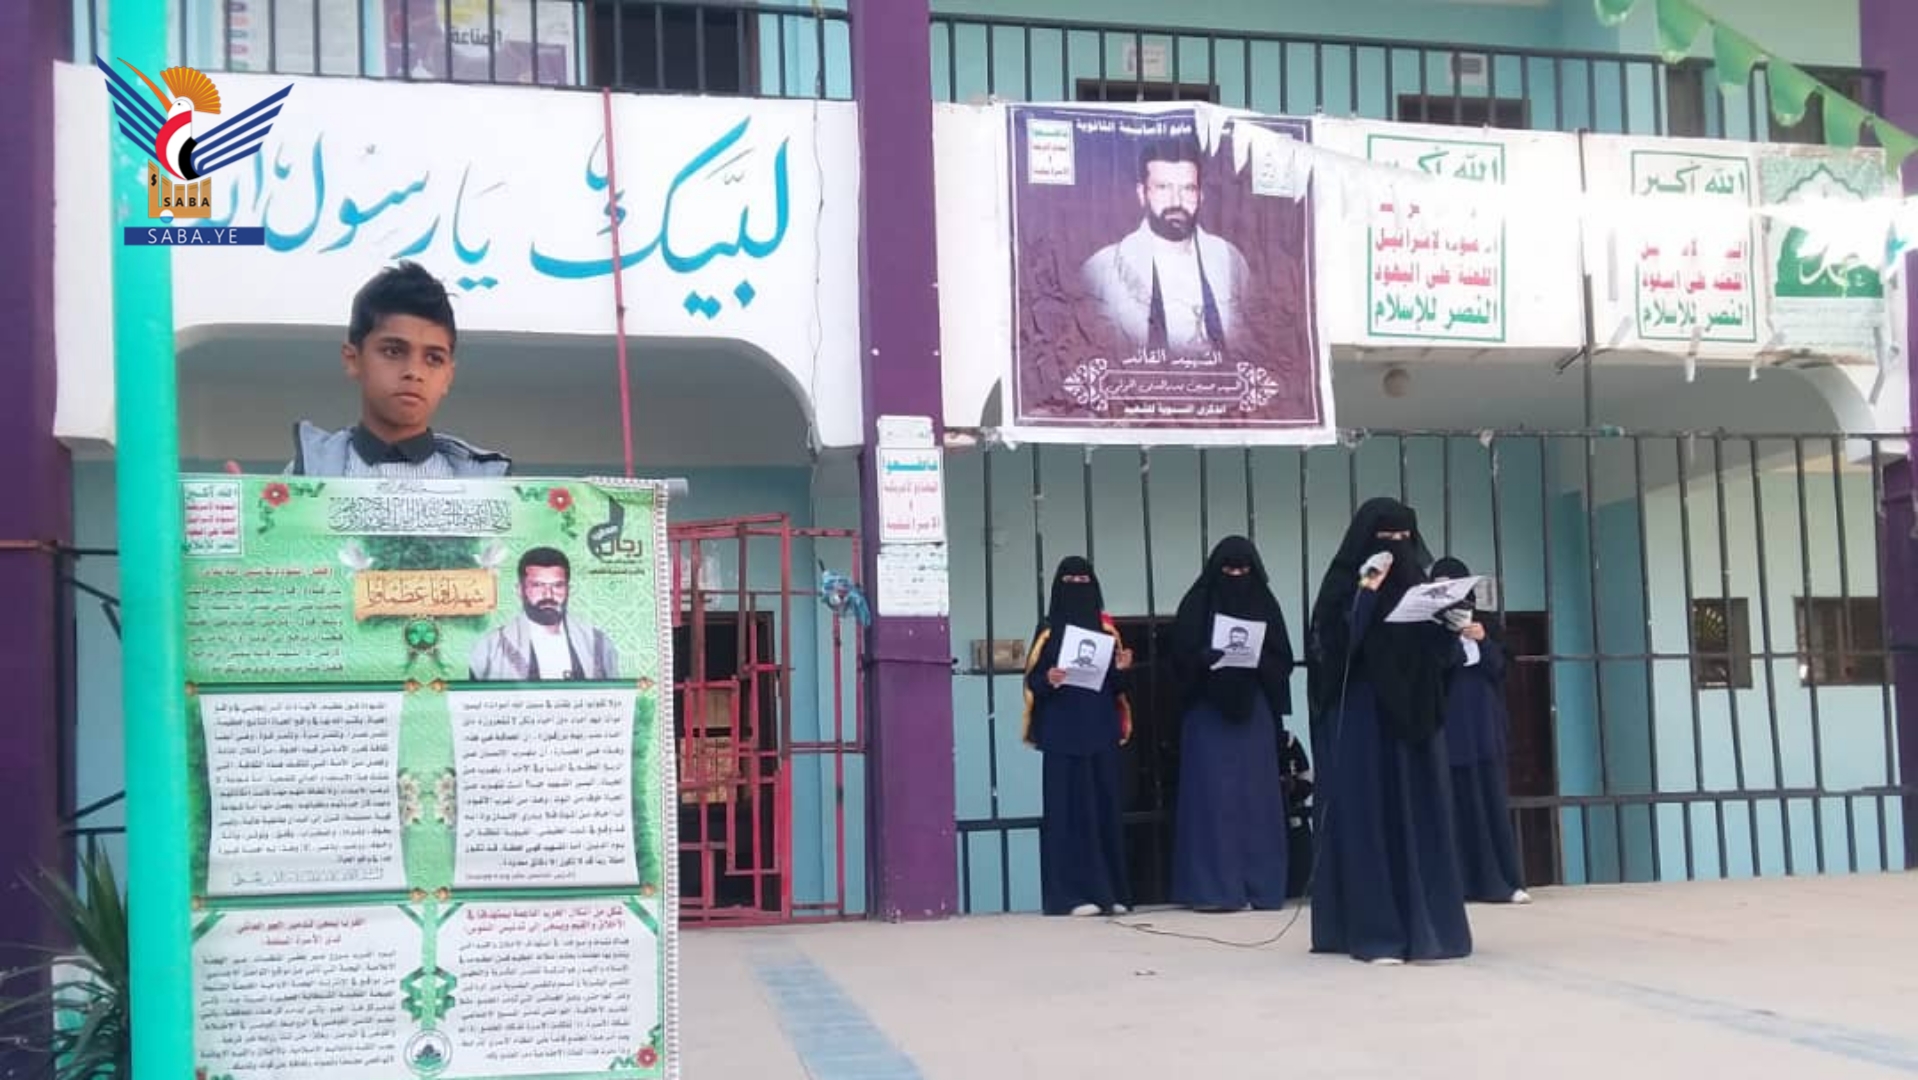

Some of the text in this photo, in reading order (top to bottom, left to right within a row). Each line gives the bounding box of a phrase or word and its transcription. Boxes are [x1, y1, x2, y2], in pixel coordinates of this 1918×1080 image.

[1453, 153, 1498, 183] الله
[1638, 160, 1746, 196] الله أكبر
[1375, 292, 1498, 331] النصر للإسلام
[1703, 298, 1749, 331] النصر
[1121, 347, 1222, 366] الشهيد القائد
